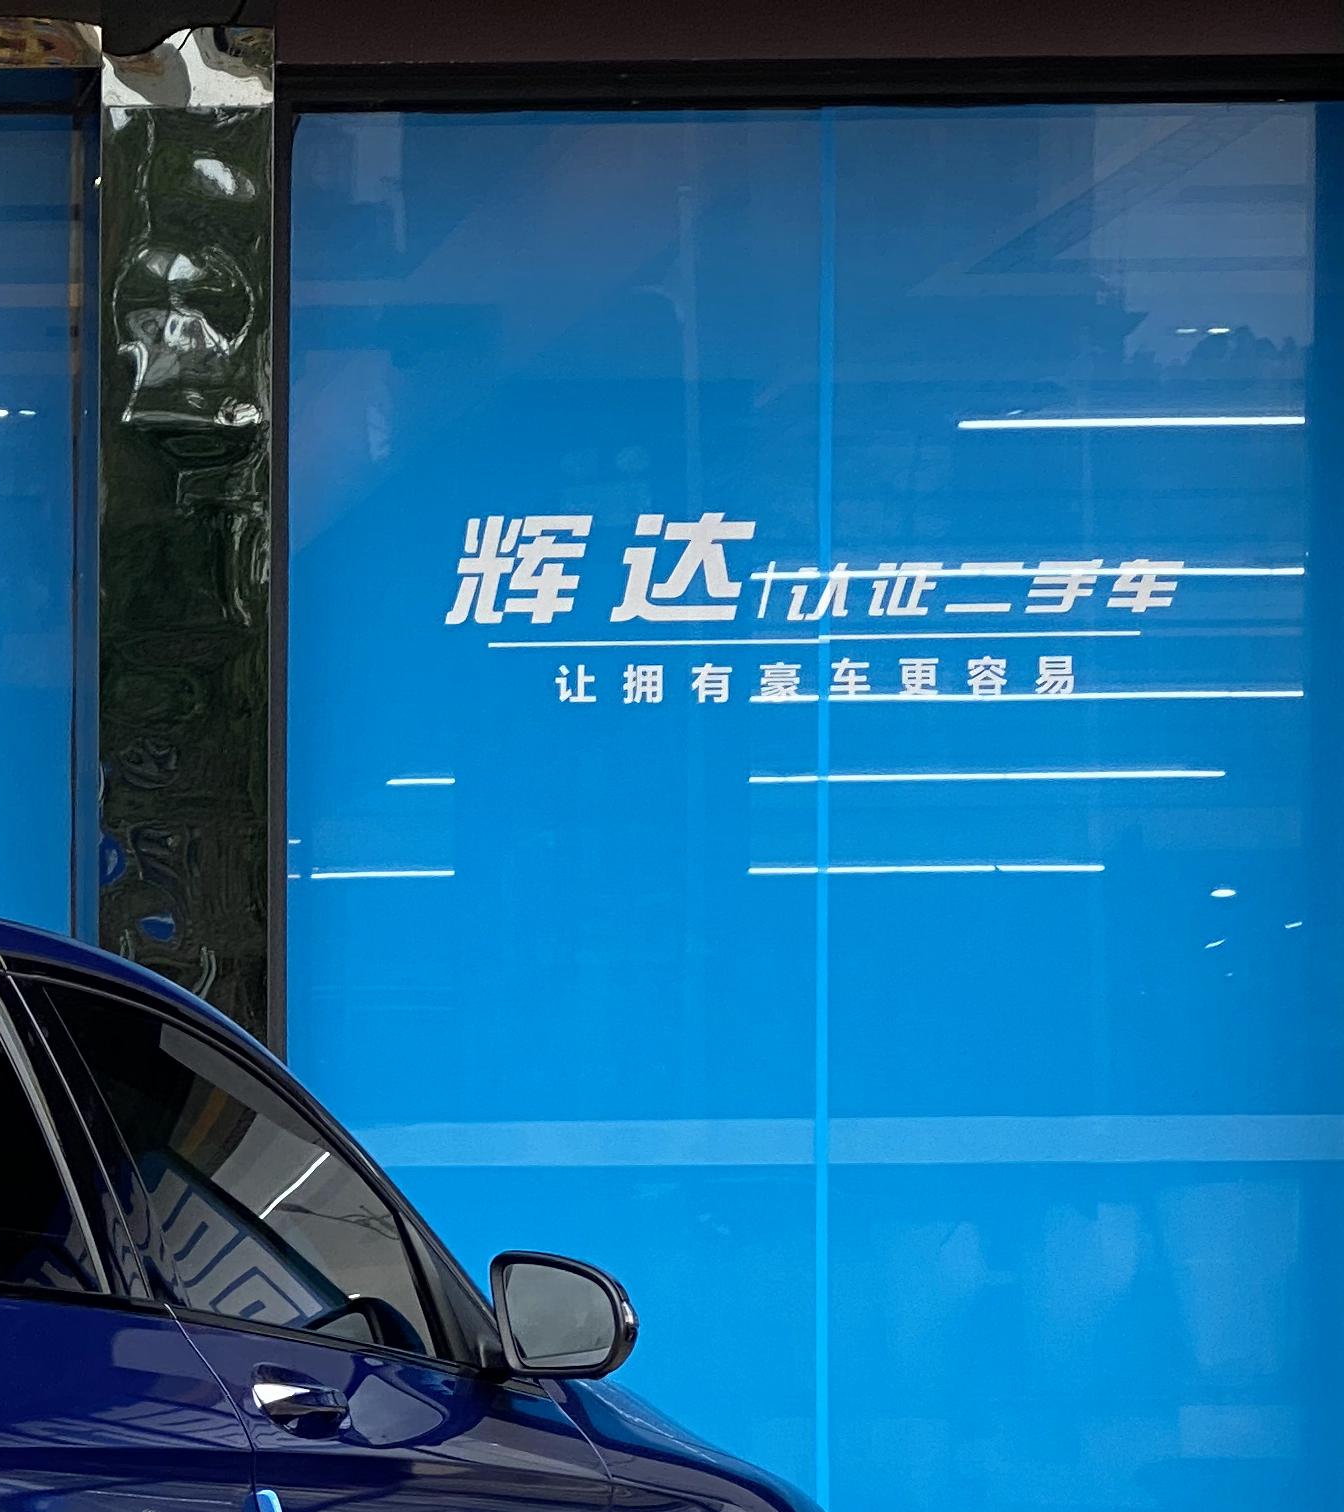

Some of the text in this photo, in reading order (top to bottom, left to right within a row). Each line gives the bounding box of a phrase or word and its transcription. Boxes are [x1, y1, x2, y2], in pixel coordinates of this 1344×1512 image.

[555, 655, 1075, 705] 让拥有豪车更容易
